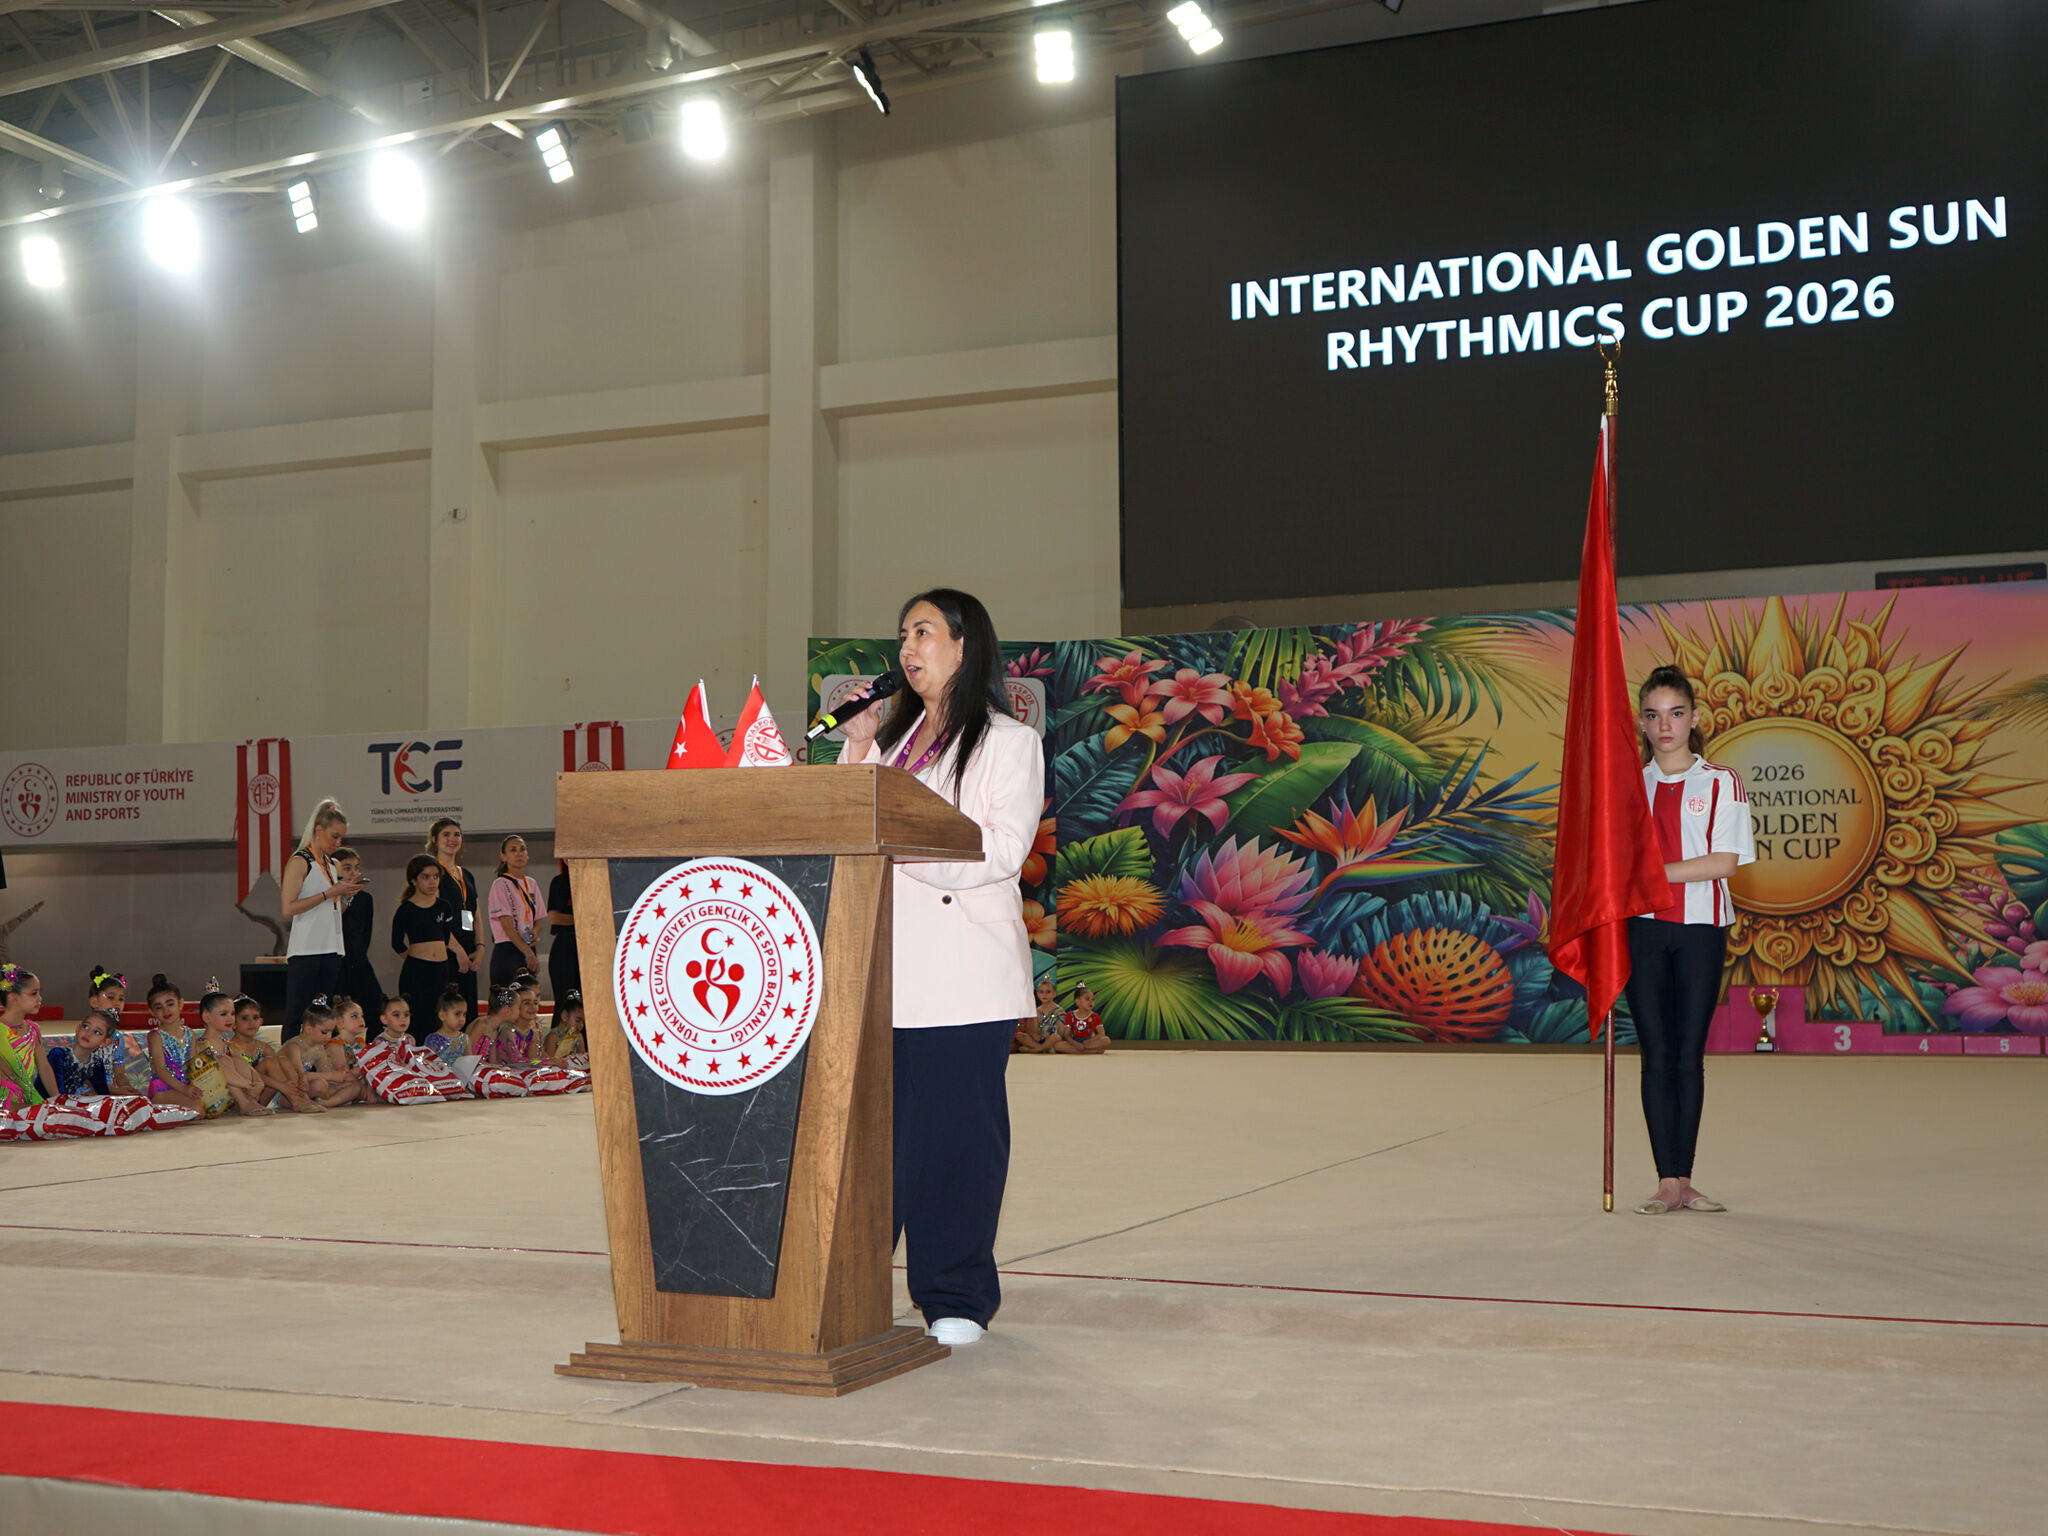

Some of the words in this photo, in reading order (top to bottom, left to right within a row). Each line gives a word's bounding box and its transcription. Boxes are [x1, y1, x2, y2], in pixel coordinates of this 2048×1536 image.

[1231, 240, 1632, 321] INTERNATIONAL
[1646, 212, 1869, 275] GOLDEN
[1888, 196, 2007, 250] SUN
[1327, 303, 1626, 371] RHYTHMICS
[1641, 290, 1748, 340] CUP
[1764, 275, 1895, 328] 2026
[66, 773, 122, 787] REPUBLIC
[124, 772, 141, 785] OF
[143, 768, 194, 784] TÜRKİYE
[1751, 765, 1805, 781] 2026
[66, 790, 120, 804] MINISTRY
[124, 790, 141, 802] OF
[143, 788, 185, 801] YOUTH
[1747, 789, 1862, 806] RNATIONAL
[66, 808, 92, 822] AND
[94, 807, 140, 821] SPORTS
[1783, 838, 1841, 860] CUP
[698, 905, 751, 926] GENÇLİK
[751, 922, 764, 940] VE
[653, 908, 697, 995] CUMHURİYETİ
[761, 940, 777, 977] SPOR
[730, 981, 777, 1043] BAKANLIĞI
[1833, 1025, 1852, 1052] 3
[1919, 1039, 1929, 1053] 4
[1999, 1039, 2011, 1053] 5
